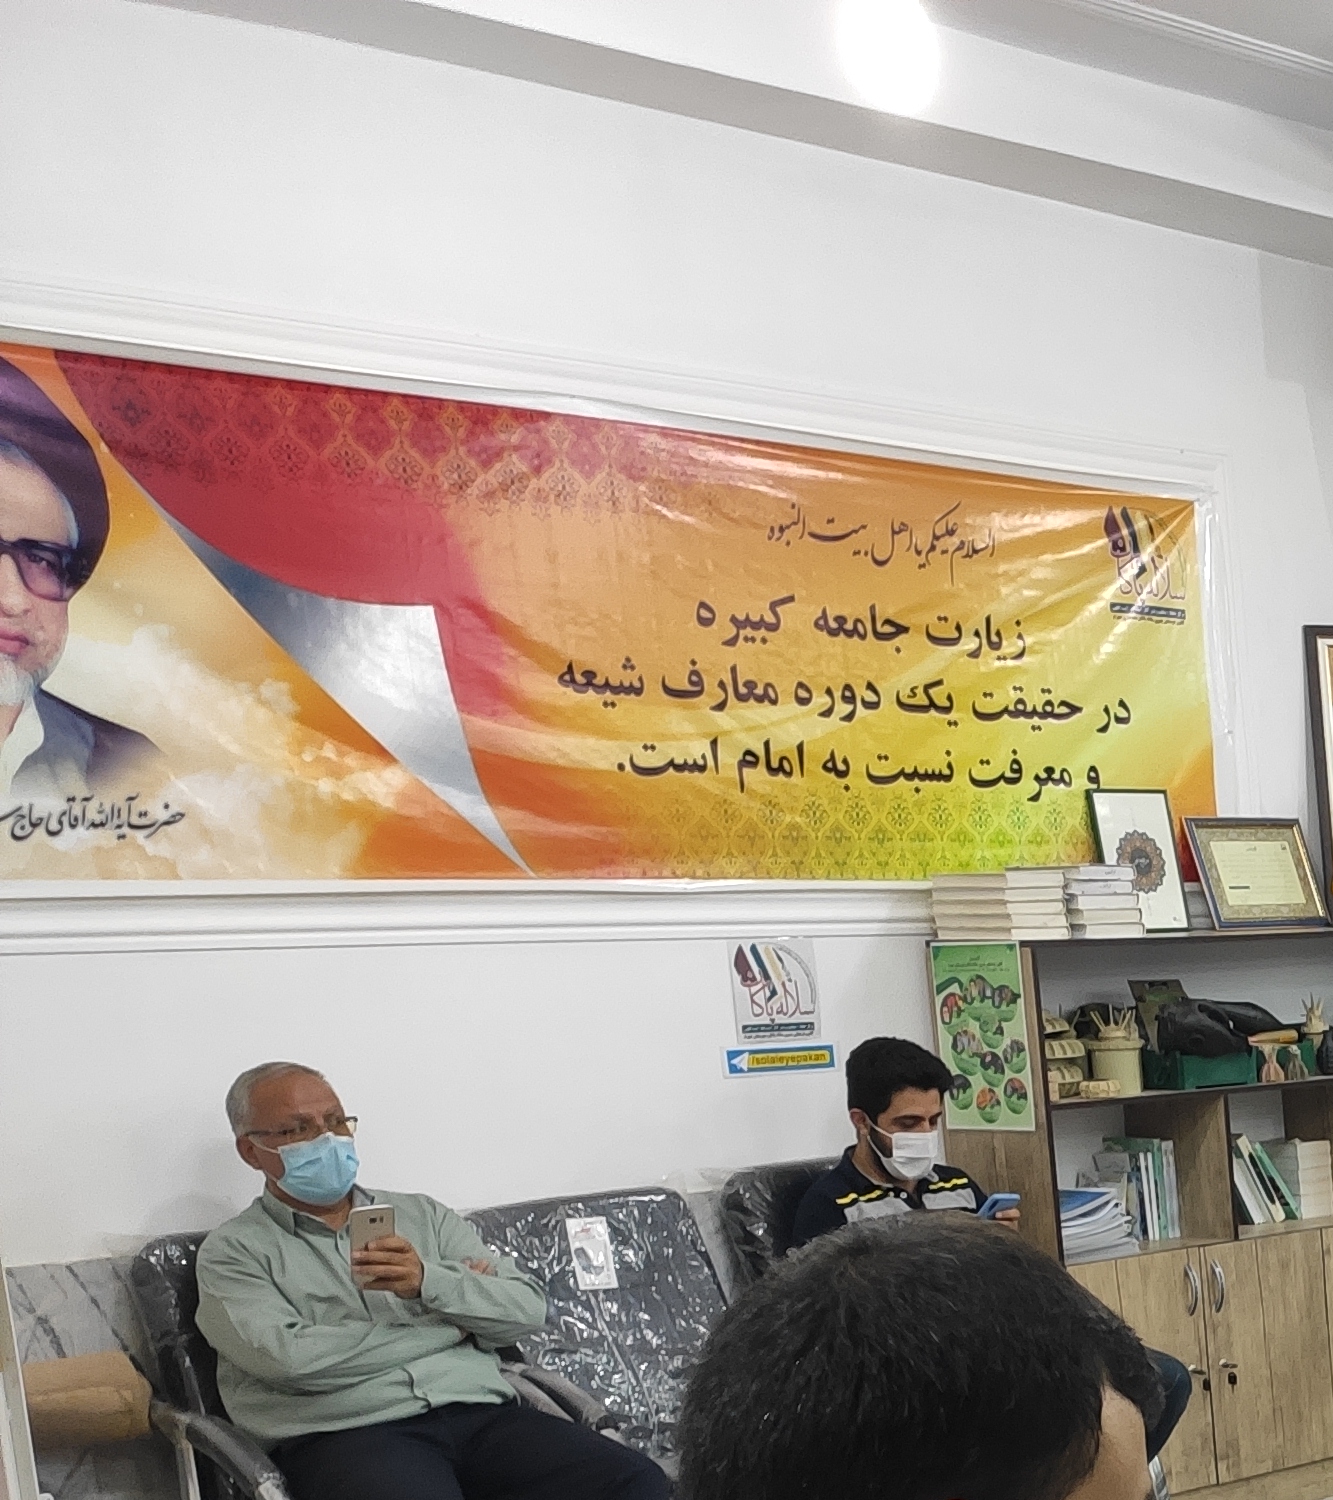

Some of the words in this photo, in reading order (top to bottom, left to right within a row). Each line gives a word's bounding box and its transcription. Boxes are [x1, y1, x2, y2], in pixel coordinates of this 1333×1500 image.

[808, 516, 868, 557] بیت
[696, 594, 795, 647] کبیره
[813, 603, 910, 655] جامعه
[925, 613, 1027, 662] زیارت
[557, 656, 645, 709] شیعه
[661, 658, 779, 712] معارف
[795, 679, 882, 723] دوره
[972, 685, 1084, 732] حقیقت
[1096, 698, 1132, 733] در
[737, 737, 805, 794] امام
[821, 749, 851, 792] به
[866, 749, 955, 794] نسبت
[968, 748, 1073, 802] معرفت
[1086, 764, 1101, 790] و
